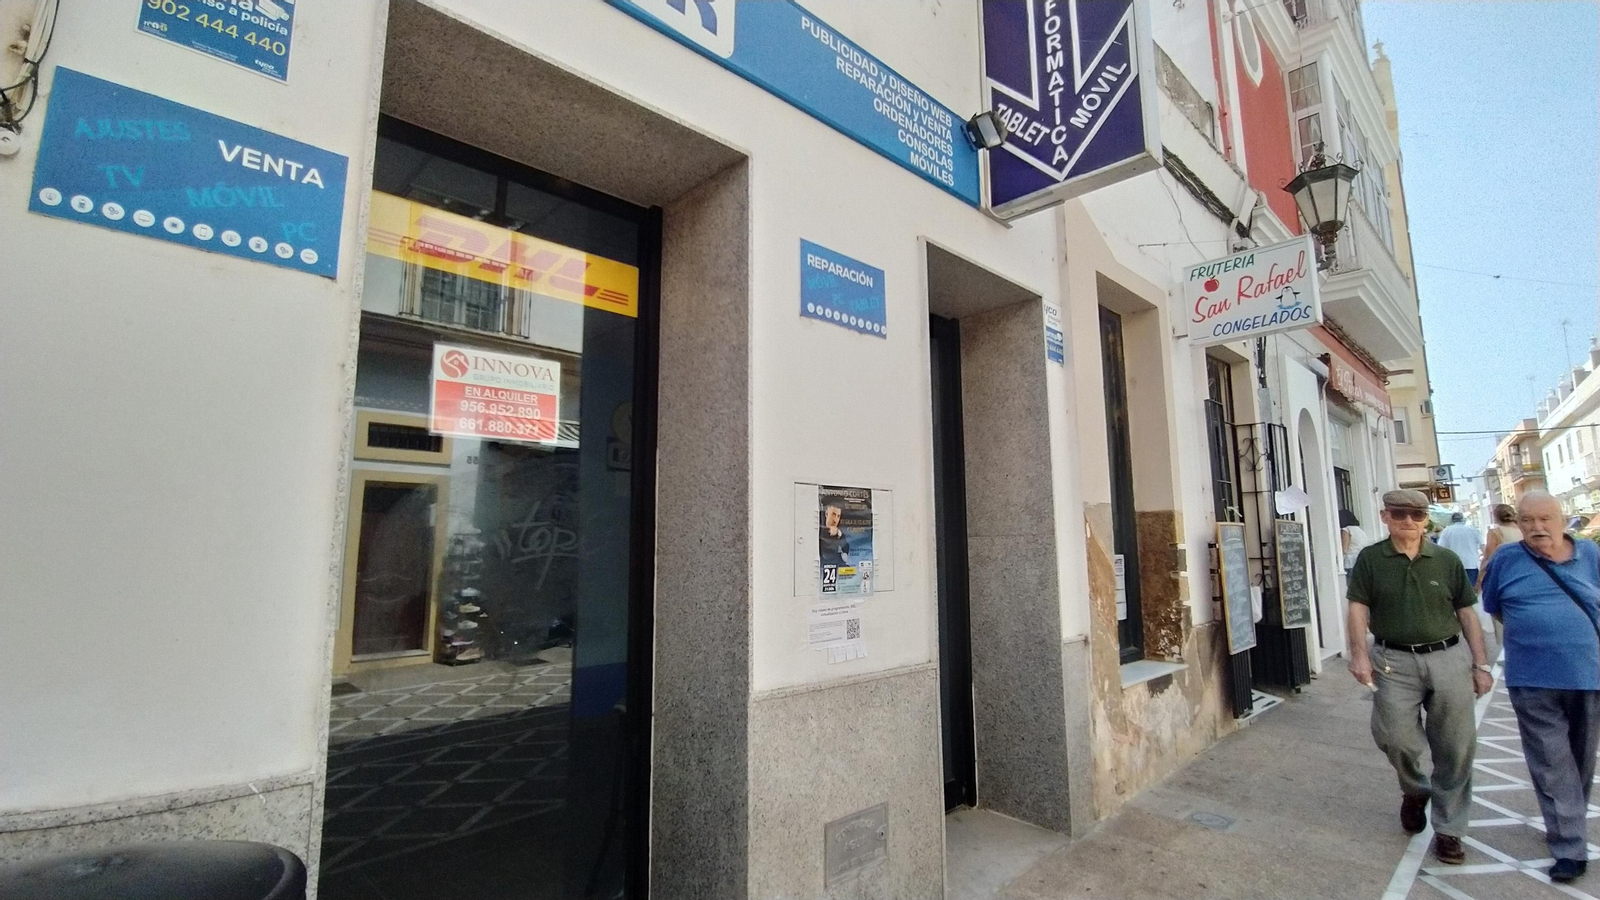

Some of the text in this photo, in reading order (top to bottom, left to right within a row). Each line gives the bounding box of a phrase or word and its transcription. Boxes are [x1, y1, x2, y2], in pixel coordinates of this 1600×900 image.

[147, 0, 191, 21] 902
[195, 14, 239, 39] 444
[244, 32, 286, 56] 440
[228, 7, 238, 16] a
[241, 12, 288, 36] policía
[801, 16, 953, 127] PUBLICIDAD y DISEÑO WEB
[836, 56, 953, 143] REPARACIÓN y VENTA
[1070, 63, 1128, 129] MÓVIL
[74, 118, 191, 141] AJUSTES
[873, 98, 953, 157] ORDENADORES
[998, 103, 1050, 146] TABLET
[218, 140, 325, 189] VENTA
[898, 129, 953, 172] CONSOLAS
[101, 164, 145, 189] TV
[910, 152, 955, 187] MÓVILES
[186, 181, 284, 208] MÓVIL
[281, 222, 317, 243] PC
[404, 214, 600, 298] DHL
[807, 253, 874, 288] REPARACIÓN
[1189, 253, 1255, 282] FRUTERIA
[1192, 250, 1307, 323] San Rafael
[1213, 305, 1312, 337] CONGELADOS
[473, 356, 555, 382] INNOVA
[473, 373, 555, 392] GRUPO INMOBILIARIO
[460, 399, 541, 420] 956.952.890
[465, 386, 538, 404] EN ALQUILER
[823, 568, 836, 584] 24
